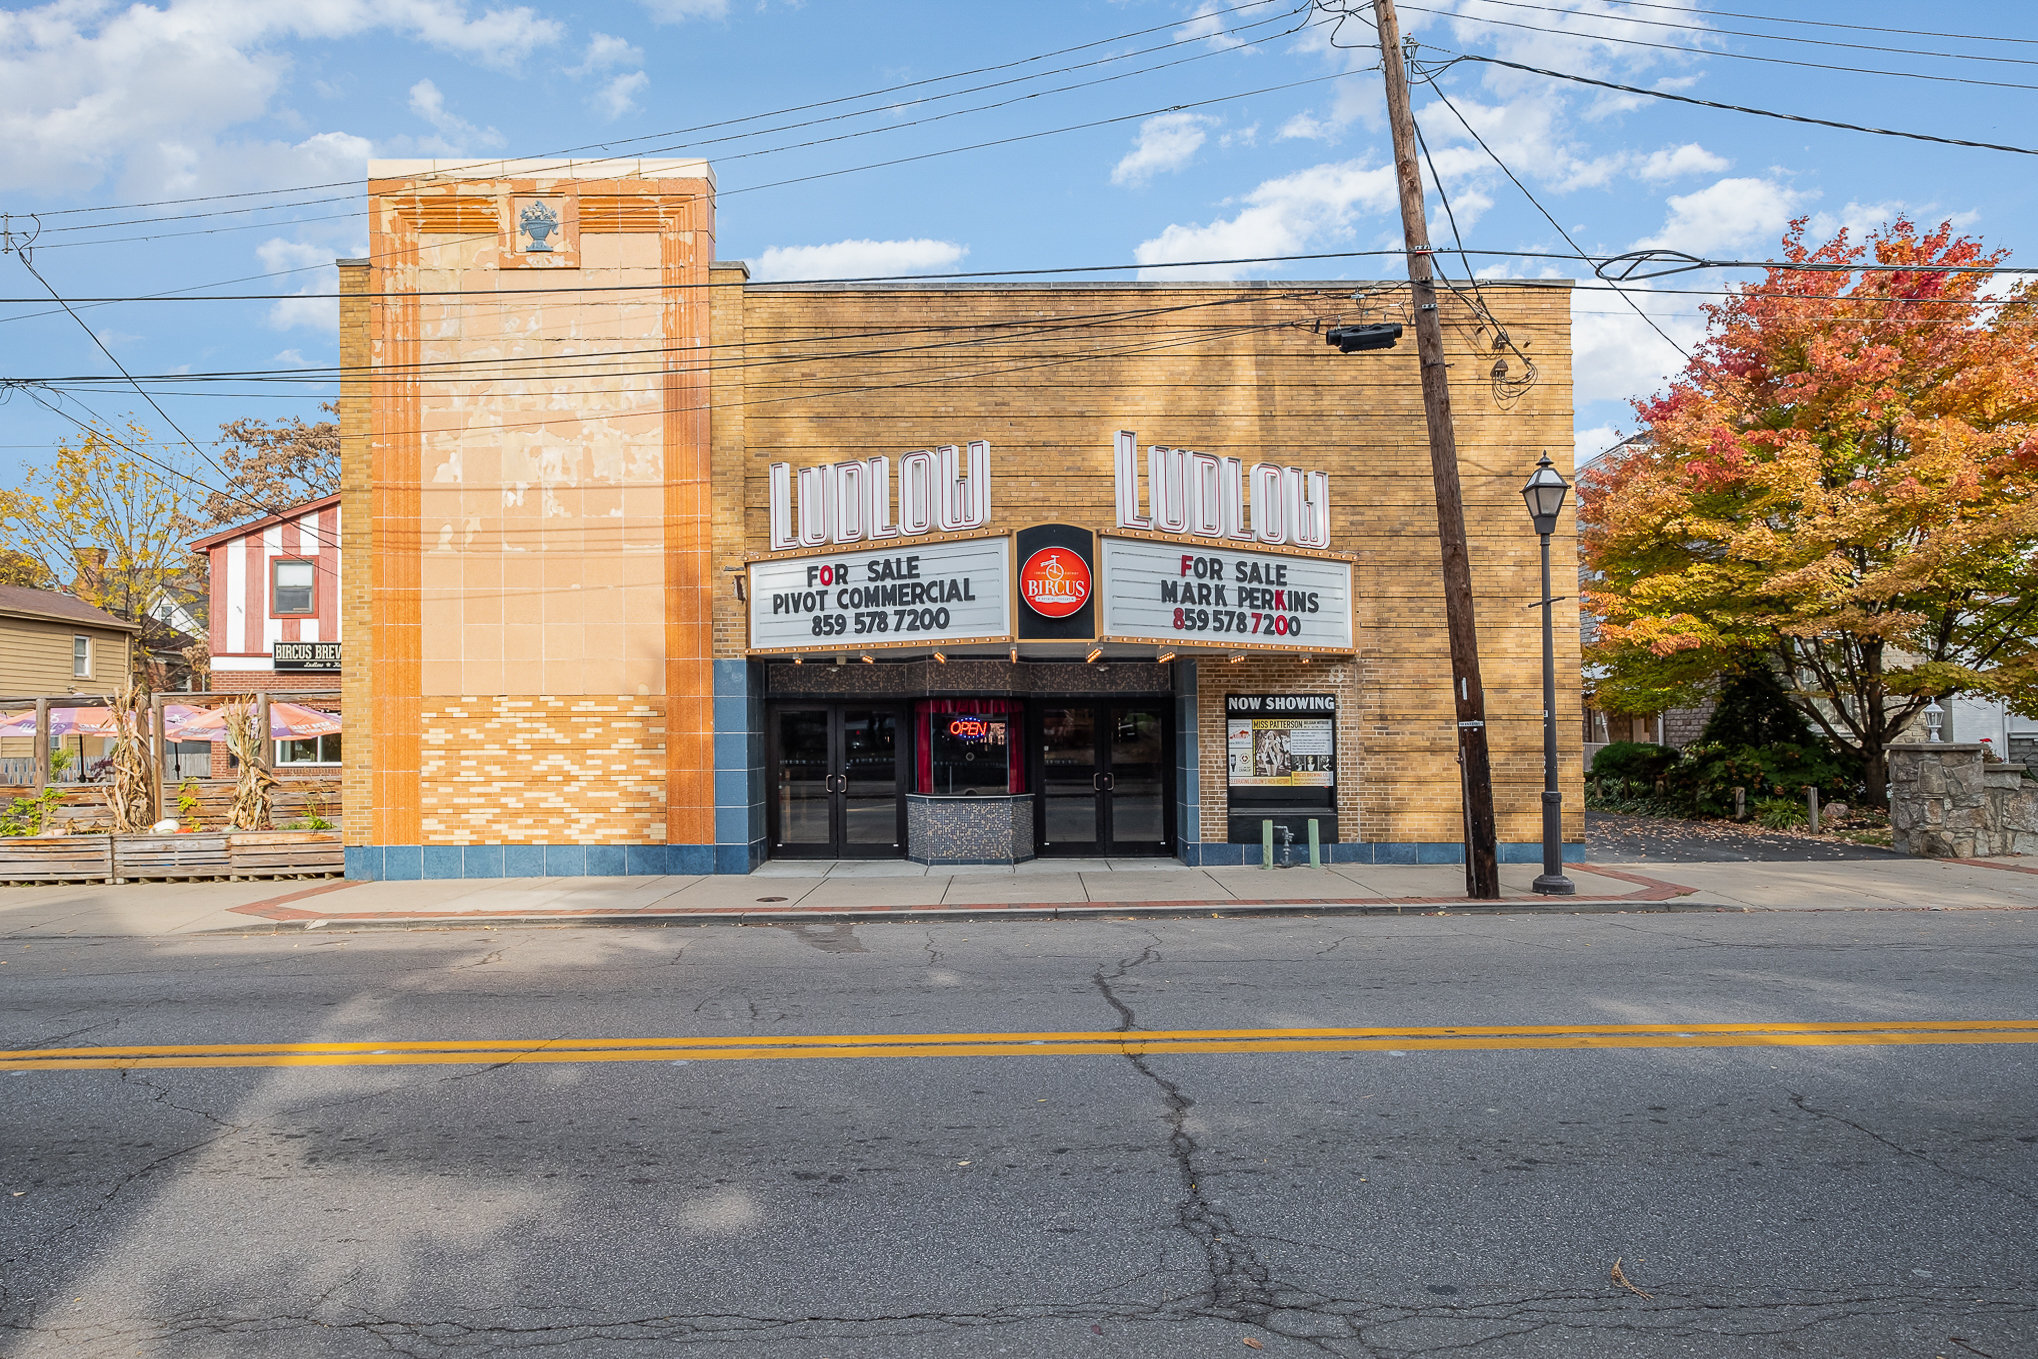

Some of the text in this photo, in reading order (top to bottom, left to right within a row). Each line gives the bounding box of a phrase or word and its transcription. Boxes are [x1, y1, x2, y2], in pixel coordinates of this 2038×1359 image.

[768, 440, 991, 551] LUDLOW
[1113, 430, 1331, 550] LUDLOW
[806, 556, 920, 588] FOR SALE
[1180, 555, 1288, 586] FOR SALE
[772, 578, 976, 614] PIVOT COMMERCIAL
[1027, 580, 1085, 597] BIRCUS
[1160, 580, 1319, 613] MARK PERKINS
[811, 607, 950, 636] 859 578 7200
[1173, 607, 1301, 637] 859 578 7200
[275, 644, 312, 659] BIRCUS
[1228, 696, 1335, 710] NOW SHOWING
[950, 721, 988, 736] OPEN
[1253, 720, 1269, 729] MISS
[1269, 720, 1303, 729] PATTERSON
